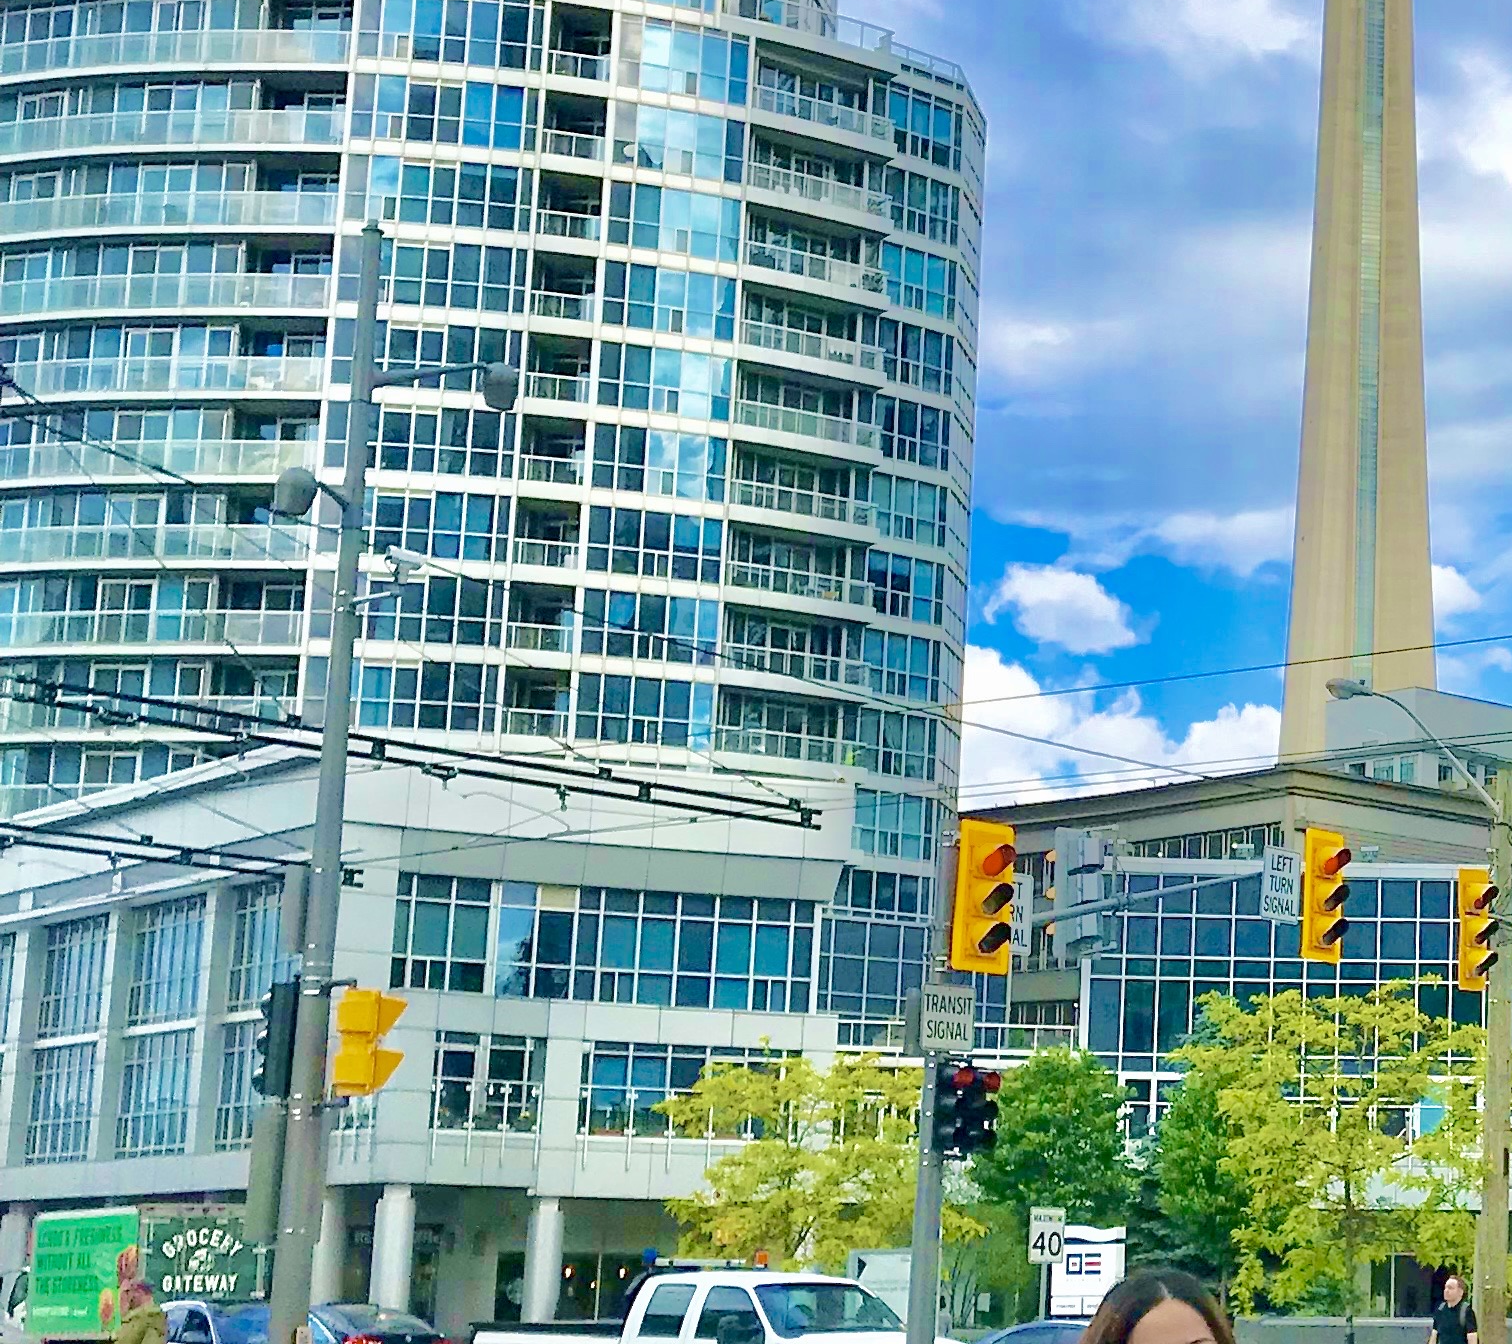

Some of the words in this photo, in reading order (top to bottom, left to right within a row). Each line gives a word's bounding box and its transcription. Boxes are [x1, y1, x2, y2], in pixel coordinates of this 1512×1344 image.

[1271, 855, 1293, 873] LEFT
[1270, 875, 1294, 895] TURN
[1263, 895, 1295, 916] SIGNAL
[925, 993, 973, 1015] TRANSIT
[926, 1019, 968, 1041] SIGNAL
[162, 1227, 244, 1258] GROCERY
[1032, 1231, 1061, 1257] 40
[162, 1273, 238, 1293] GATEWAY
